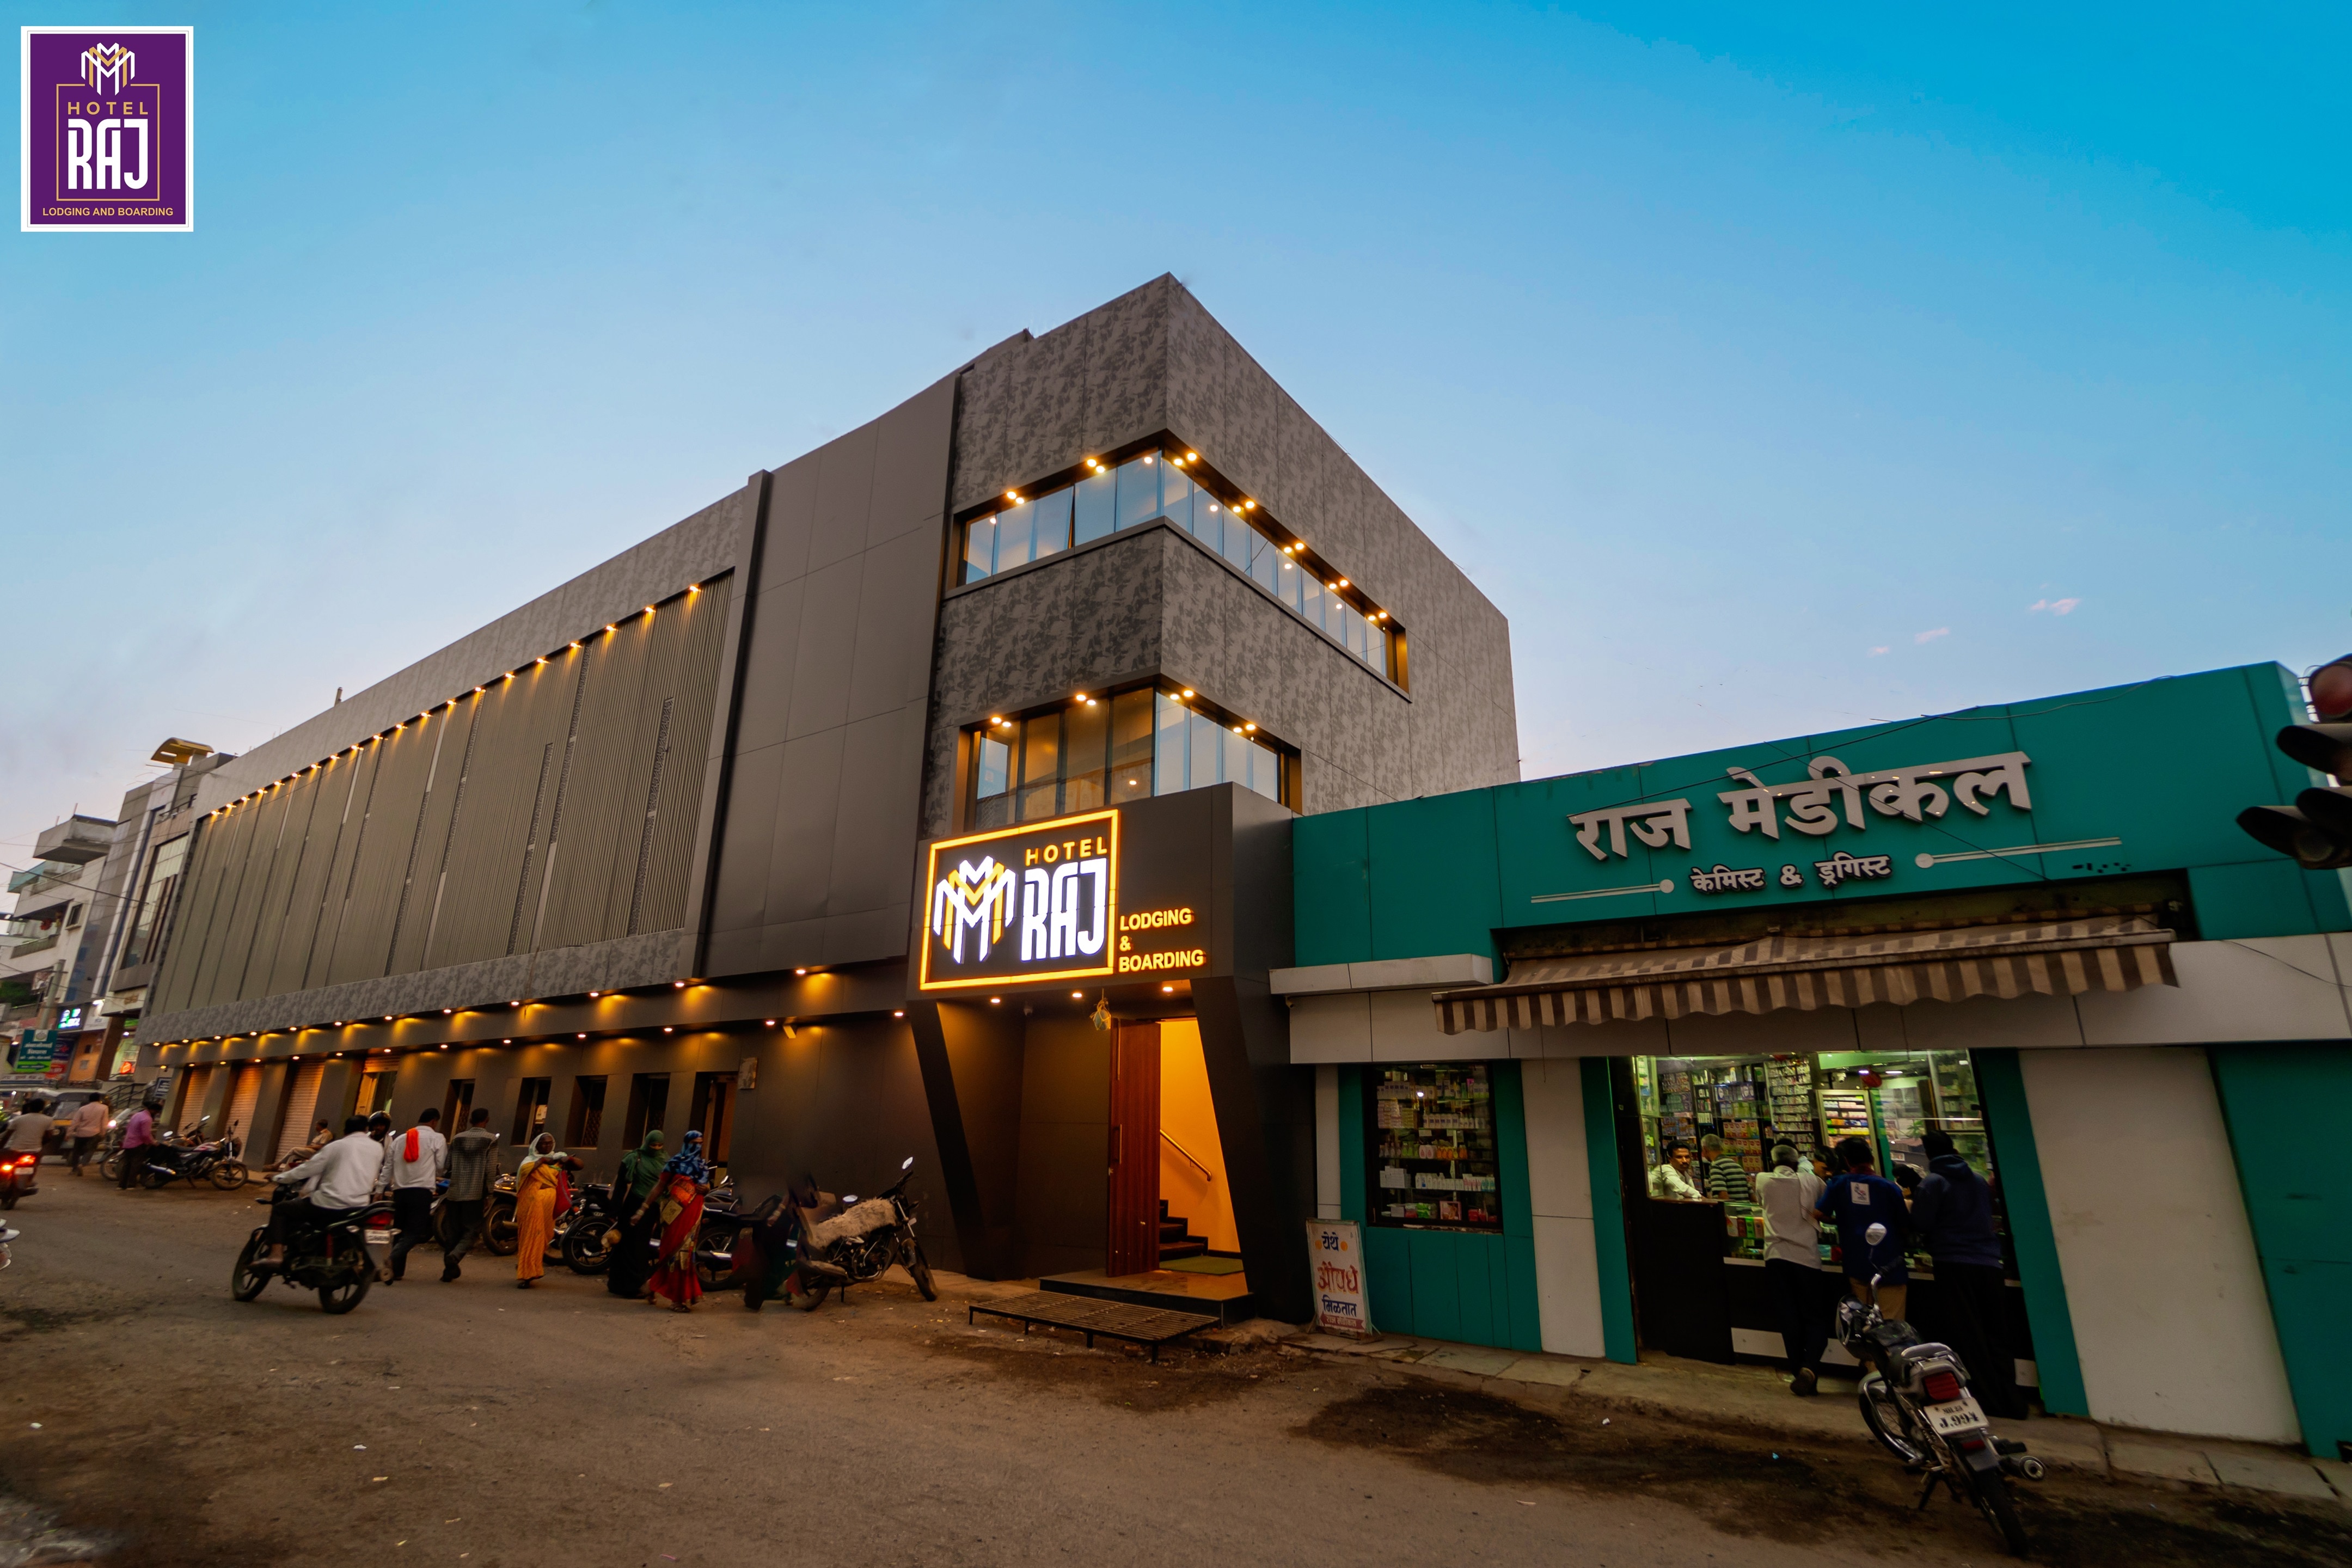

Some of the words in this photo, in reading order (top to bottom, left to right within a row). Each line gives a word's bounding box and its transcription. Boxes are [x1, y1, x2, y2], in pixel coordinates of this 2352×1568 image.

[1566, 798, 1693, 860] राज
[1717, 751, 2032, 840] मेडीकल
[1025, 836, 1108, 866] HOTEL
[1689, 863, 1767, 893] केमिस्ट
[1779, 863, 1804, 887] &
[1813, 850, 1892, 889] ड्रगिस्ट
[1021, 857, 1108, 961] RAJ
[1119, 908, 1194, 931] LODGING
[1119, 935, 1131, 952] &
[1119, 949, 1205, 973] BOARDING
[1321, 1232, 1339, 1251] येथे
[1321, 1294, 1357, 1318] मिळतात
